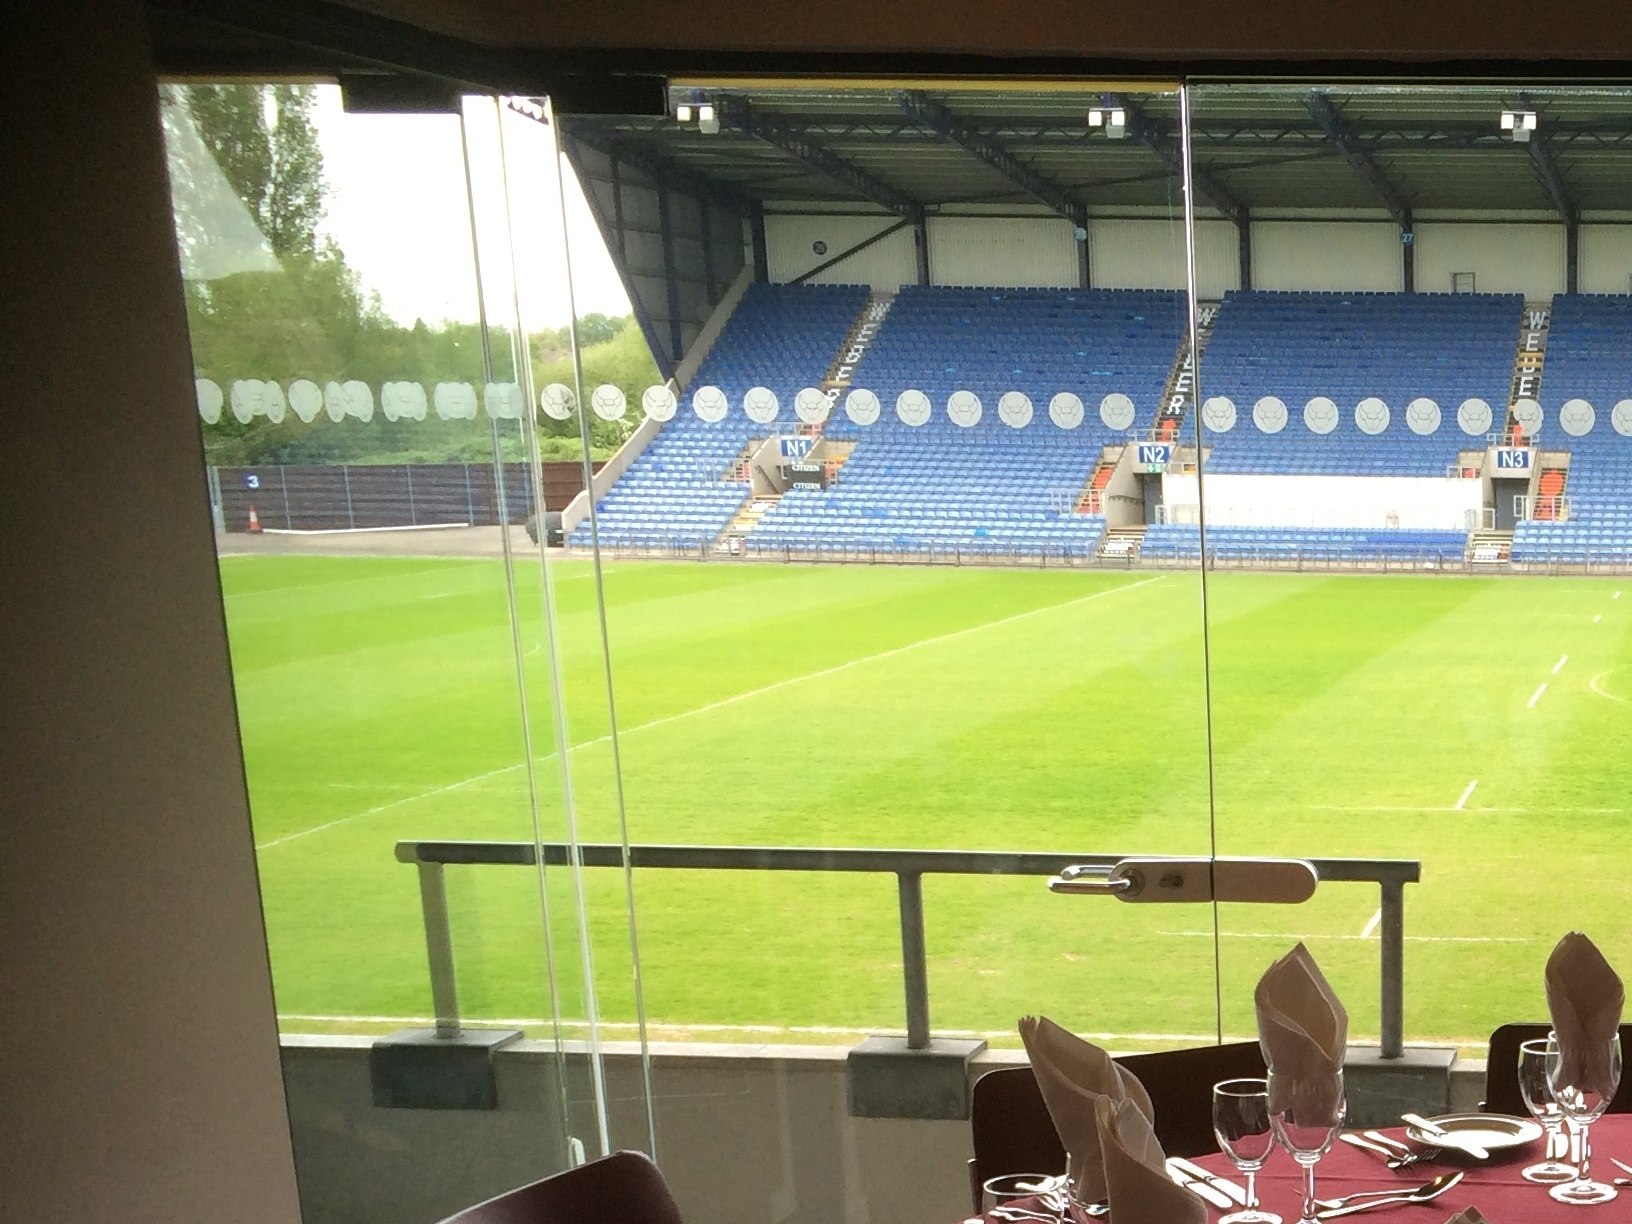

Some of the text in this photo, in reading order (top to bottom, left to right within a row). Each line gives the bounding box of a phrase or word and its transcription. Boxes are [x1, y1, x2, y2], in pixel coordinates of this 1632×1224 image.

[1401, 233, 1413, 243] 27
[1518, 311, 1547, 396] WEE
[786, 441, 808, 456] N1
[1143, 446, 1165, 463] N2
[1502, 451, 1524, 468] N3
[247, 475, 259, 488] 3
